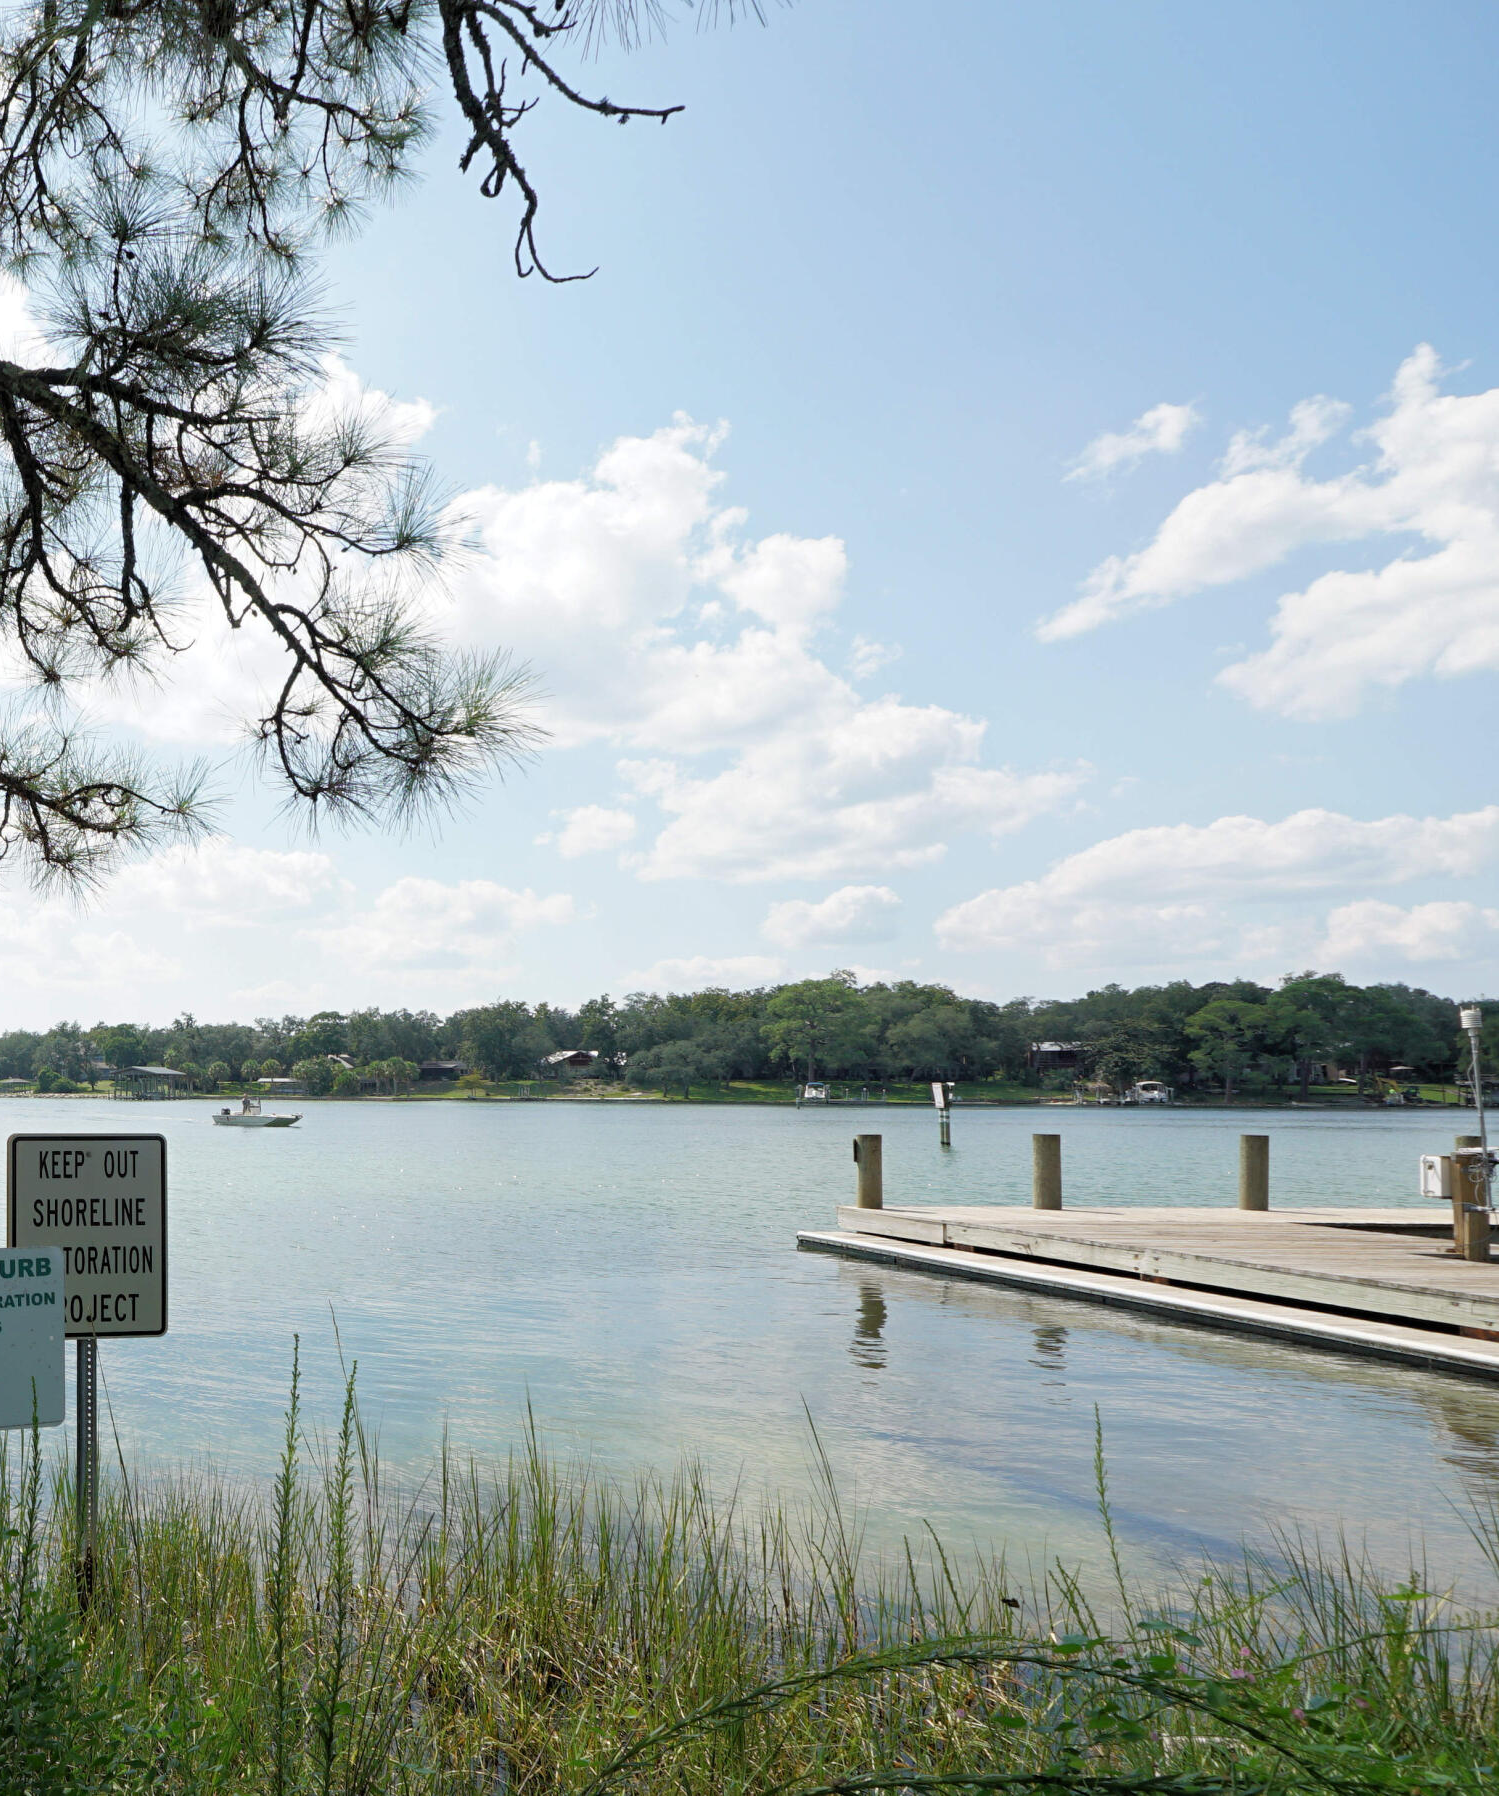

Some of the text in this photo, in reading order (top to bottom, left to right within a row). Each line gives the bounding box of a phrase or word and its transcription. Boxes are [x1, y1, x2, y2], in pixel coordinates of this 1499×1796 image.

[39, 1150, 139, 1179] KEEP OUT
[33, 1198, 146, 1227] SHORELINE
[63, 1246, 153, 1275] TORATION
[64, 1294, 140, 1323] OJECT
